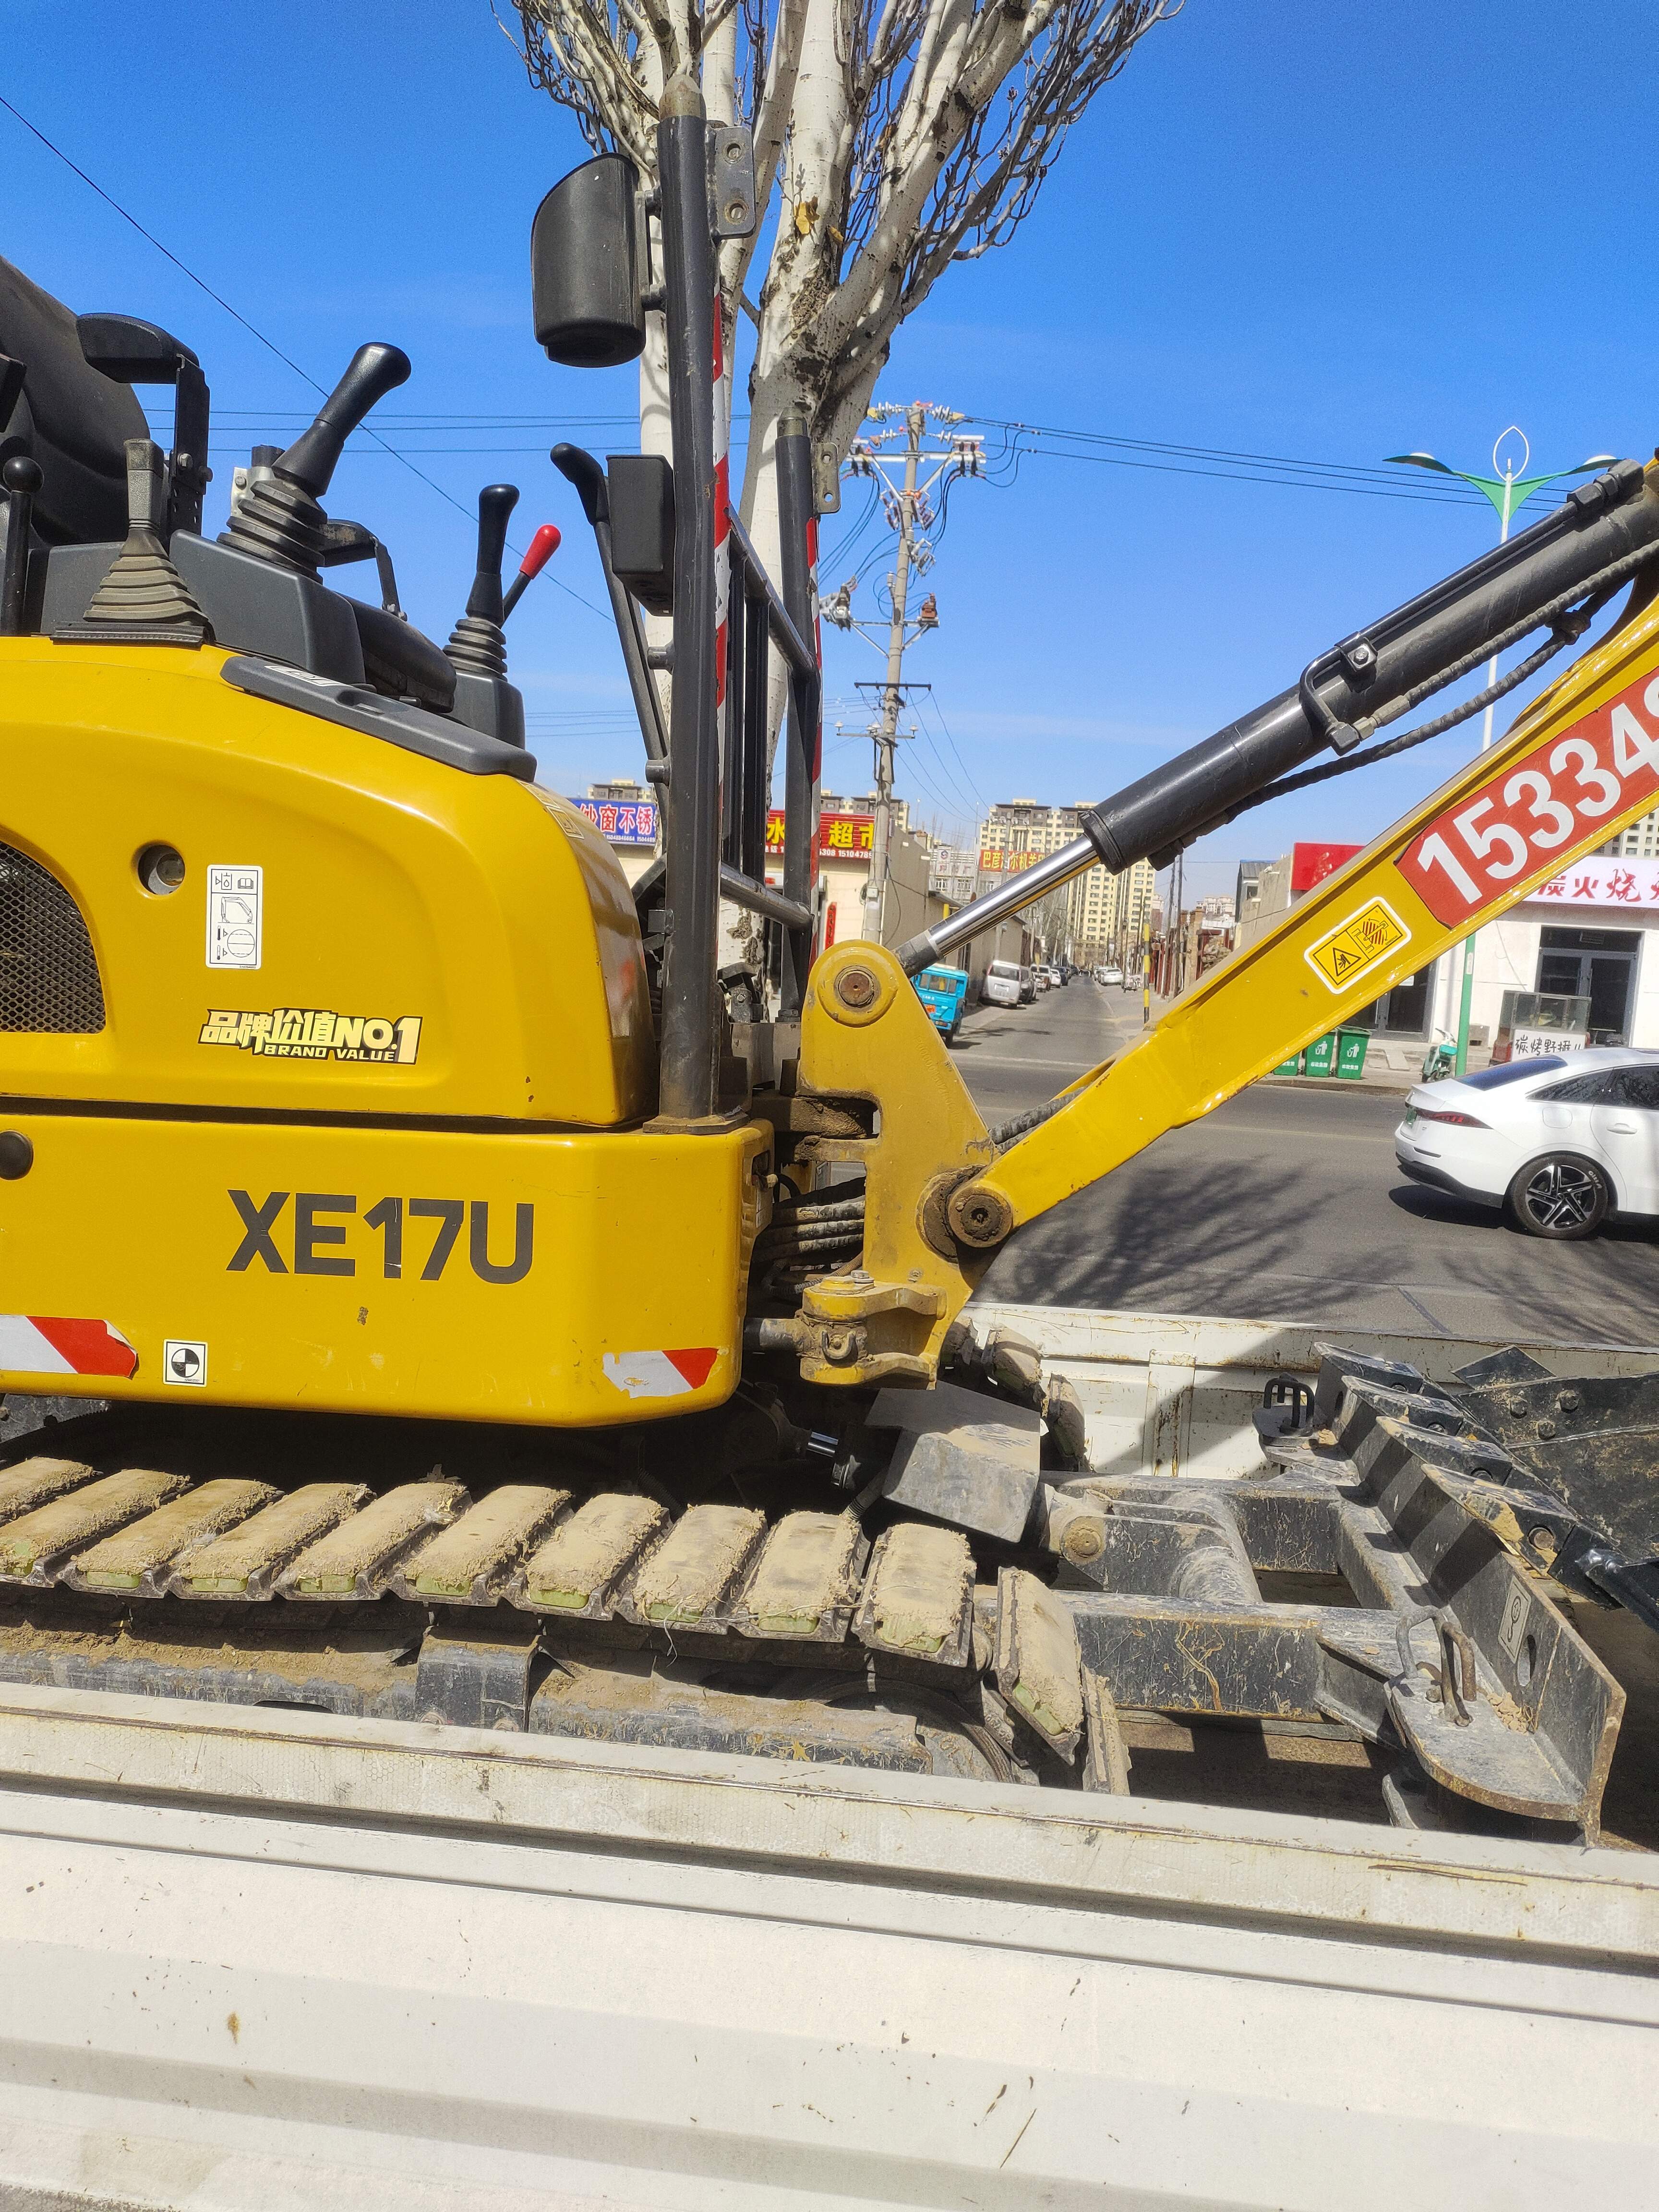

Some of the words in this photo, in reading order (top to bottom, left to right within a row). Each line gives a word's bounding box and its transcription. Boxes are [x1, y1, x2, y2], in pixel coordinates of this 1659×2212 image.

[580, 803, 656, 835] 纱窗不锈
[983, 851, 1045, 870] 巴彦尔机关
[264, 1044, 327, 1058] BRAND
[337, 1048, 395, 1061] VALUE
[227, 1190, 534, 1284] XE17U
